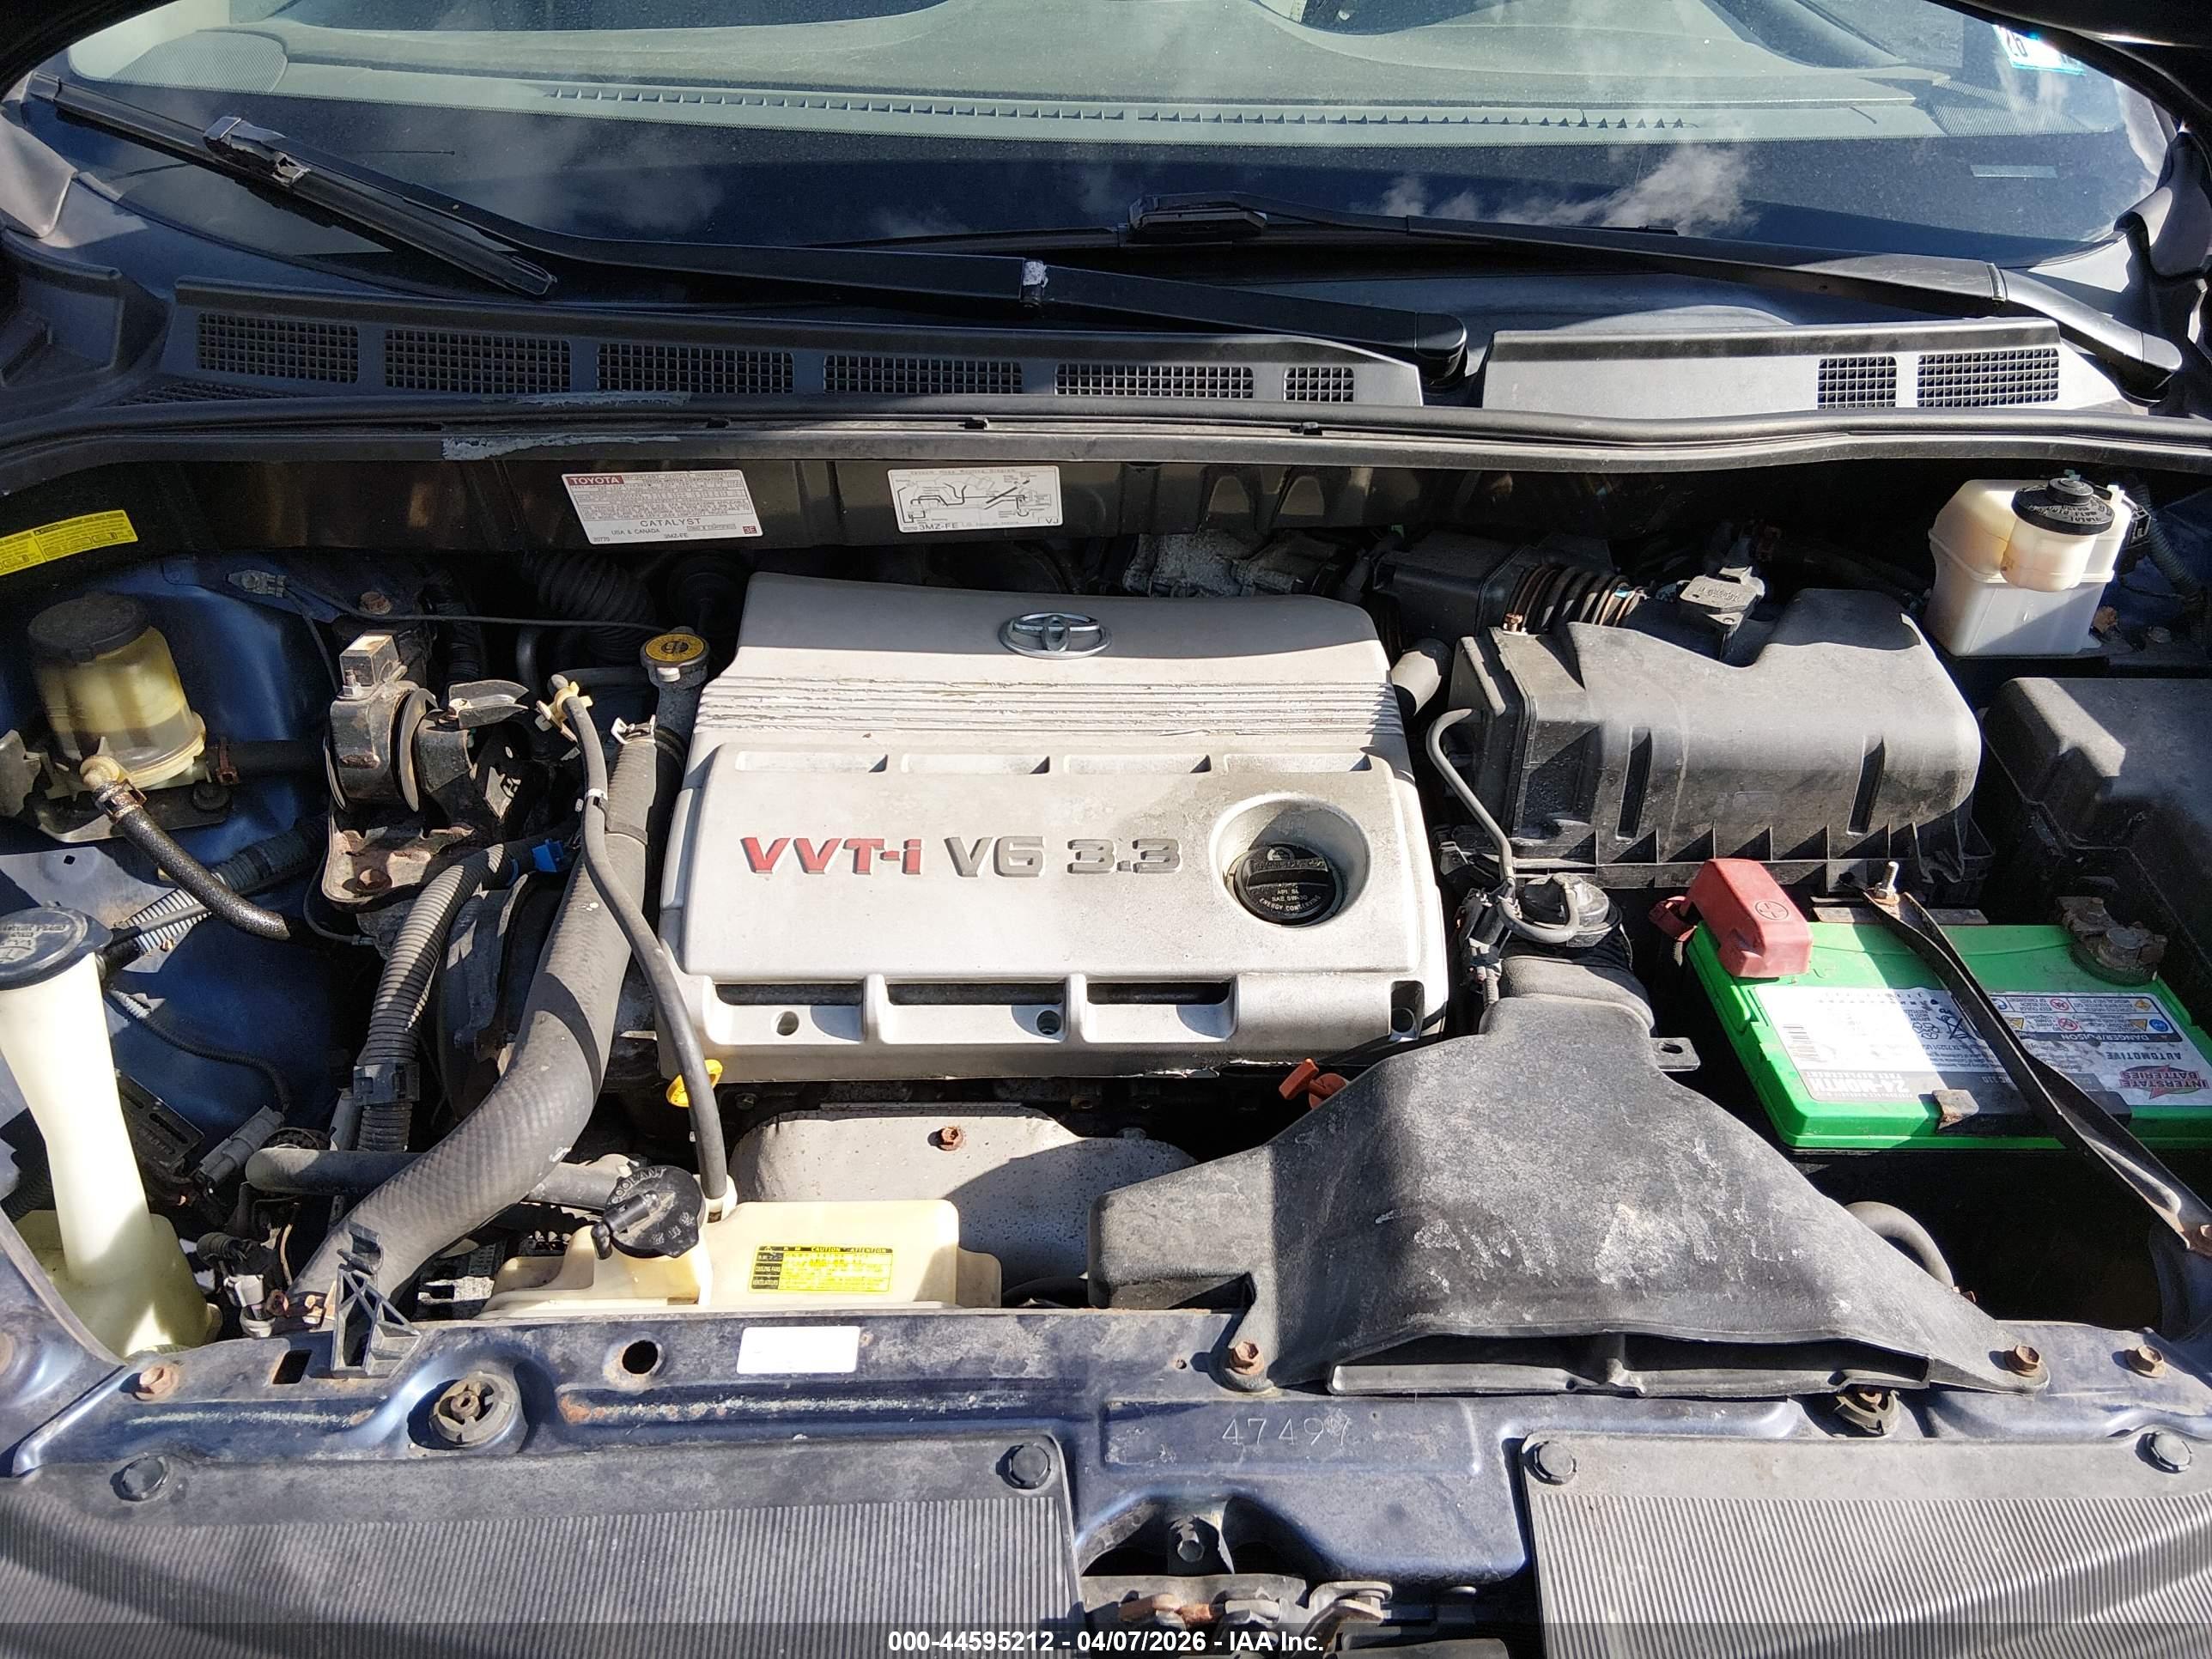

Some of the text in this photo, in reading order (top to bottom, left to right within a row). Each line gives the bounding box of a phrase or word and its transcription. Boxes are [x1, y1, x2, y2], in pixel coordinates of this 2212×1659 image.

[569, 477, 620, 485] TOYOTA
[640, 518, 702, 527] CATALYST
[740, 836, 1182, 878] VVT-i V6 3.3
[1259, 897, 1284, 911] ENERGY
[2105, 1051, 2182, 1060] AUTOMOTIVE
[1808, 1078, 1910, 1093] 24-MONTH
[2122, 1079, 2207, 1088] INTERSTATE
[611, 1167, 667, 1204] COOLANT
[1221, 1417, 1351, 1446] 47497
